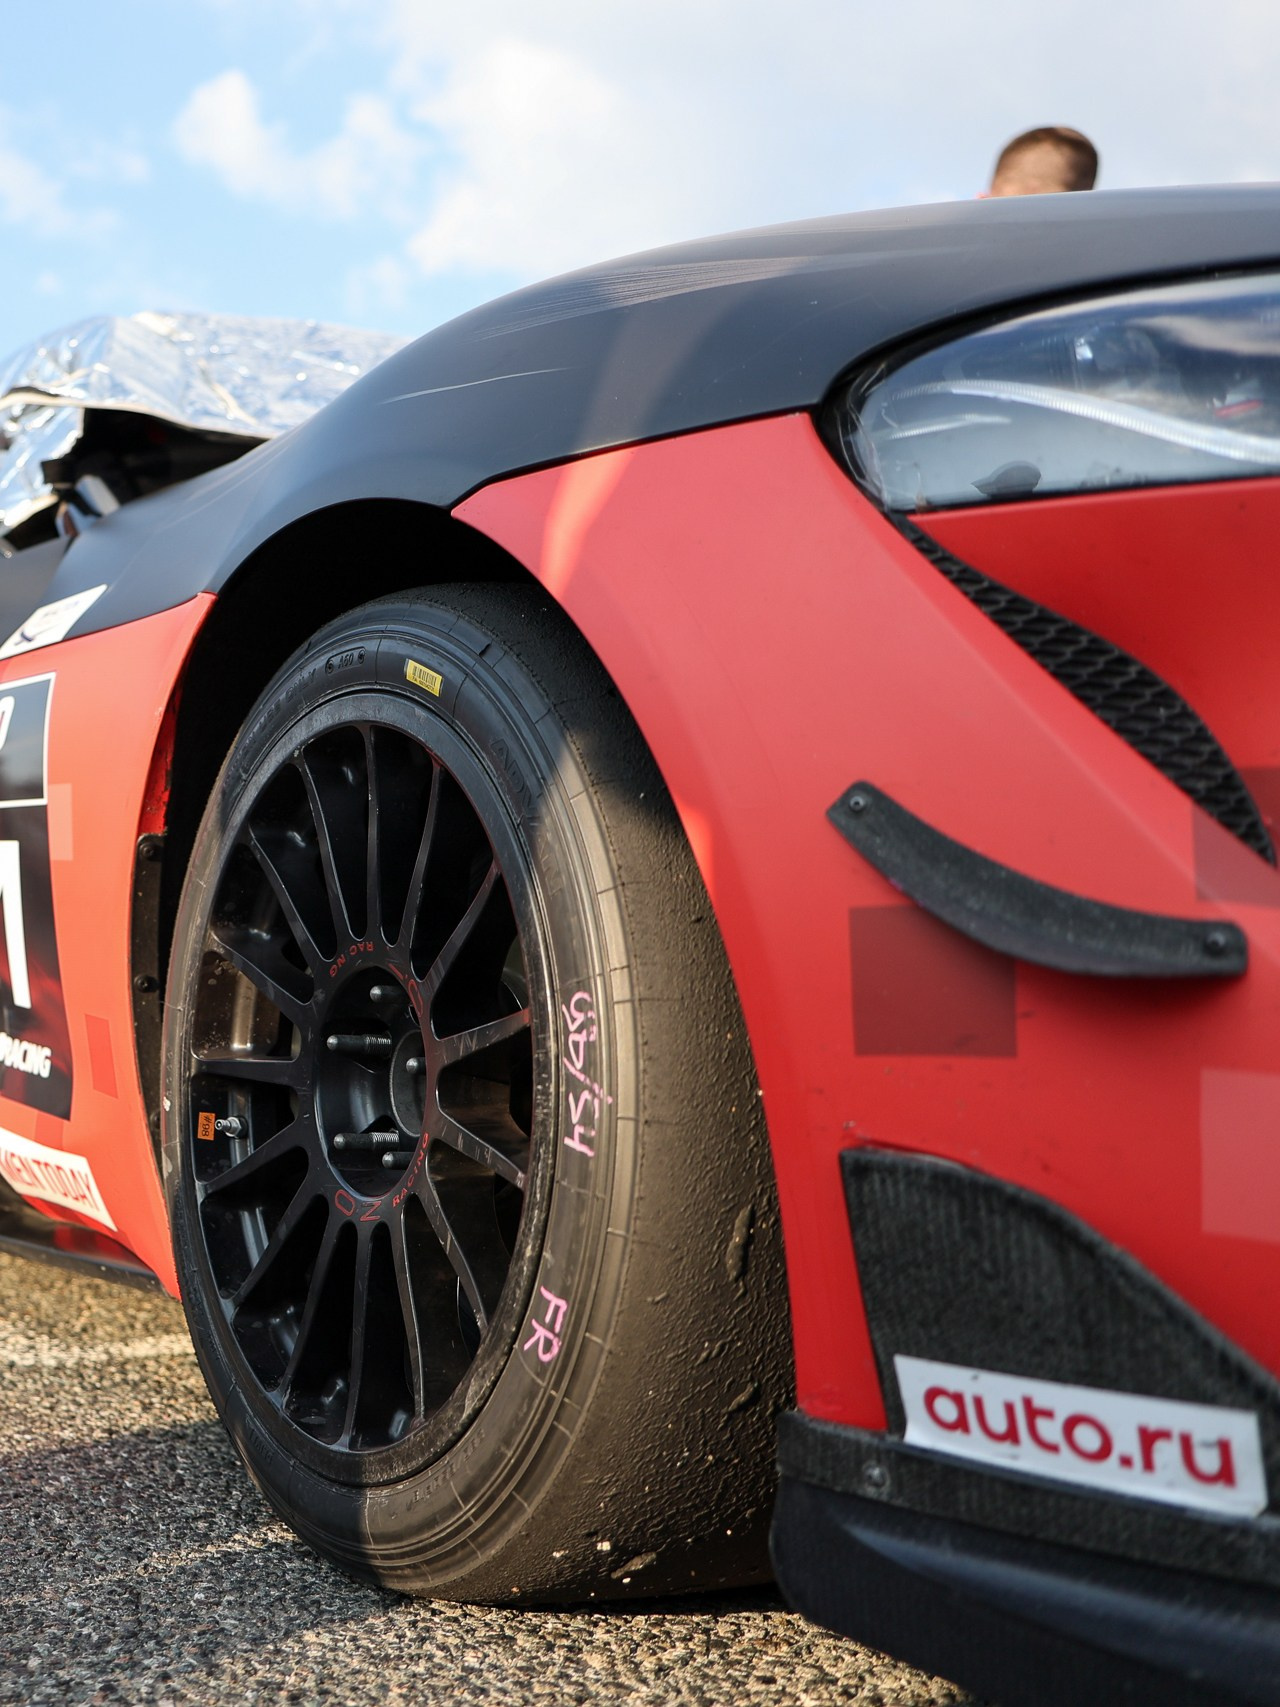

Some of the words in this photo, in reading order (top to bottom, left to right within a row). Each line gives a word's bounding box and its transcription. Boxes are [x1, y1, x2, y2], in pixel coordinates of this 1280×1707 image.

[329, 941, 374, 978] RACNG
[392, 1132, 429, 1208] RACING
[523, 1285, 568, 1362] FR
[923, 1385, 1237, 1489] auto.ru
